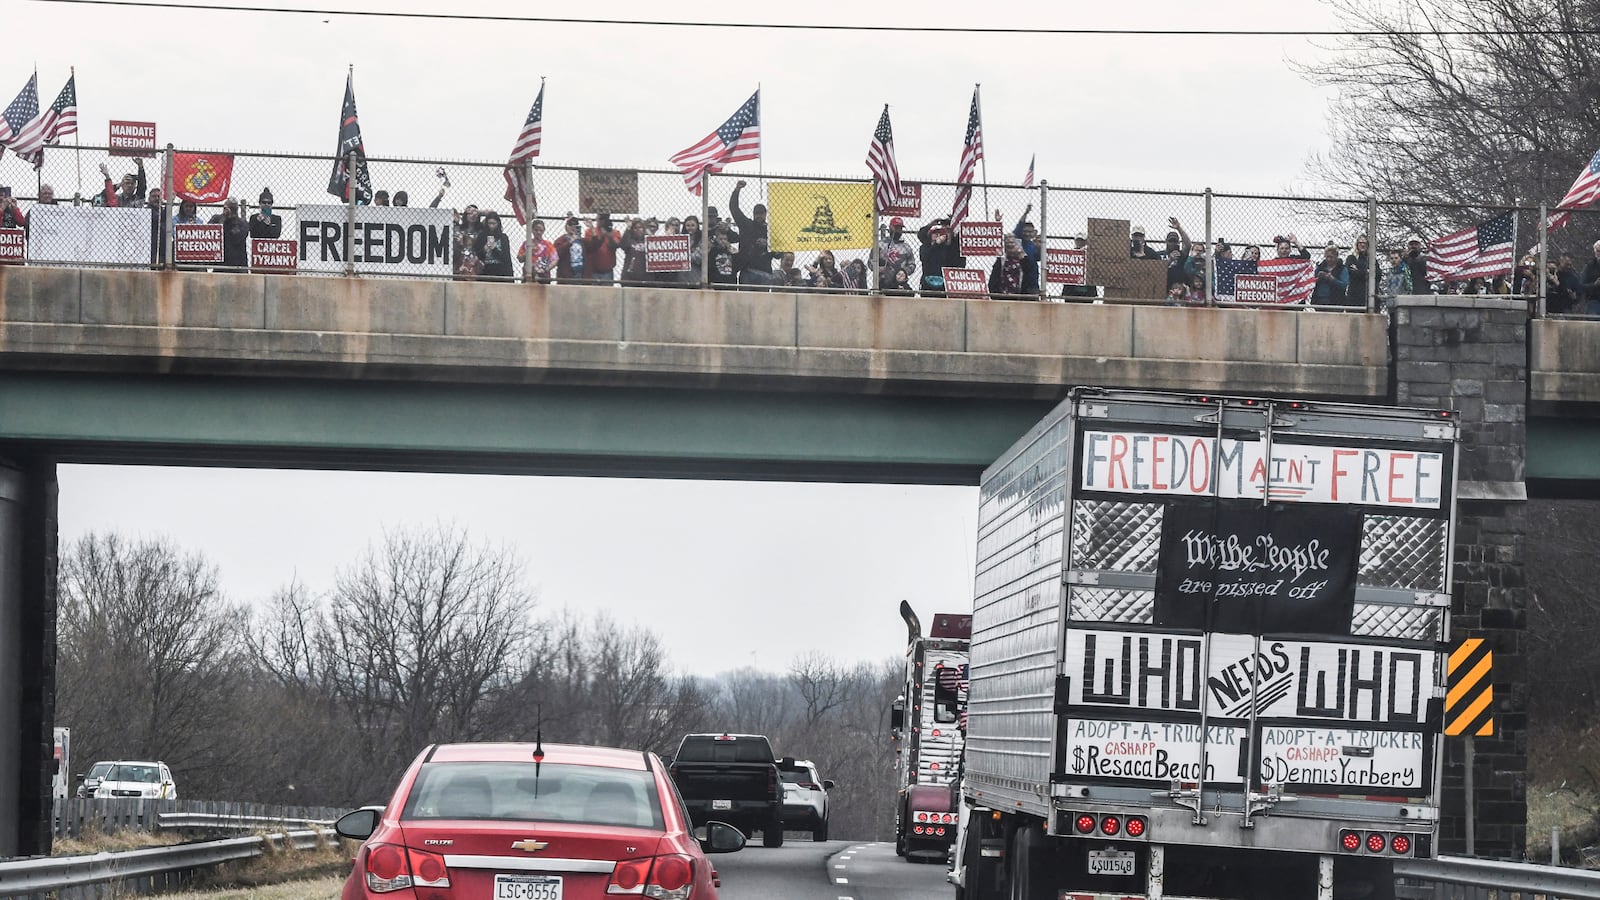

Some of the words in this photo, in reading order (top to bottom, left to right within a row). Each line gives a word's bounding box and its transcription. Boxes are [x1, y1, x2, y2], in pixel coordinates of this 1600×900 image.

[111, 125, 154, 137] MANDATE
[111, 136, 154, 149] FREEDOM
[891, 197, 920, 208] RANNY
[177, 229, 220, 240] MANDATE
[962, 226, 1002, 237] MANDATE
[177, 240, 220, 252] FREEDOM
[257, 242, 292, 254] CANCEL
[300, 220, 450, 265] FREEDOM
[647, 240, 688, 251] MANDATE
[962, 237, 1002, 248] FREEDOM
[252, 254, 296, 267] TYRANNY
[648, 251, 688, 262] FREEDOM
[948, 271, 982, 281] CANCEL
[946, 281, 986, 292] TYRANNY
[1237, 280, 1276, 291] MANDATE
[1236, 290, 1275, 301] FREEDOM
[1086, 433, 1244, 495] FREEDOM
[1249, 455, 1321, 485] AIN'T
[1331, 449, 1440, 503] FREE
[1181, 529, 1220, 570] We
[1249, 533, 1330, 584] People
[1178, 578, 1213, 594] are
[1213, 578, 1285, 602] pissed
[1288, 579, 1329, 600] off
[1082, 634, 1201, 711] WHO
[1207, 642, 1290, 710] NEEDS
[1296, 646, 1422, 722] WHO
[1105, 742, 1156, 755] CASHAPP
[1286, 747, 1339, 761] CASHAPP
[1071, 745, 1215, 781] $ResacaBeach
[1260, 755, 1414, 787] $DennisYarbery
